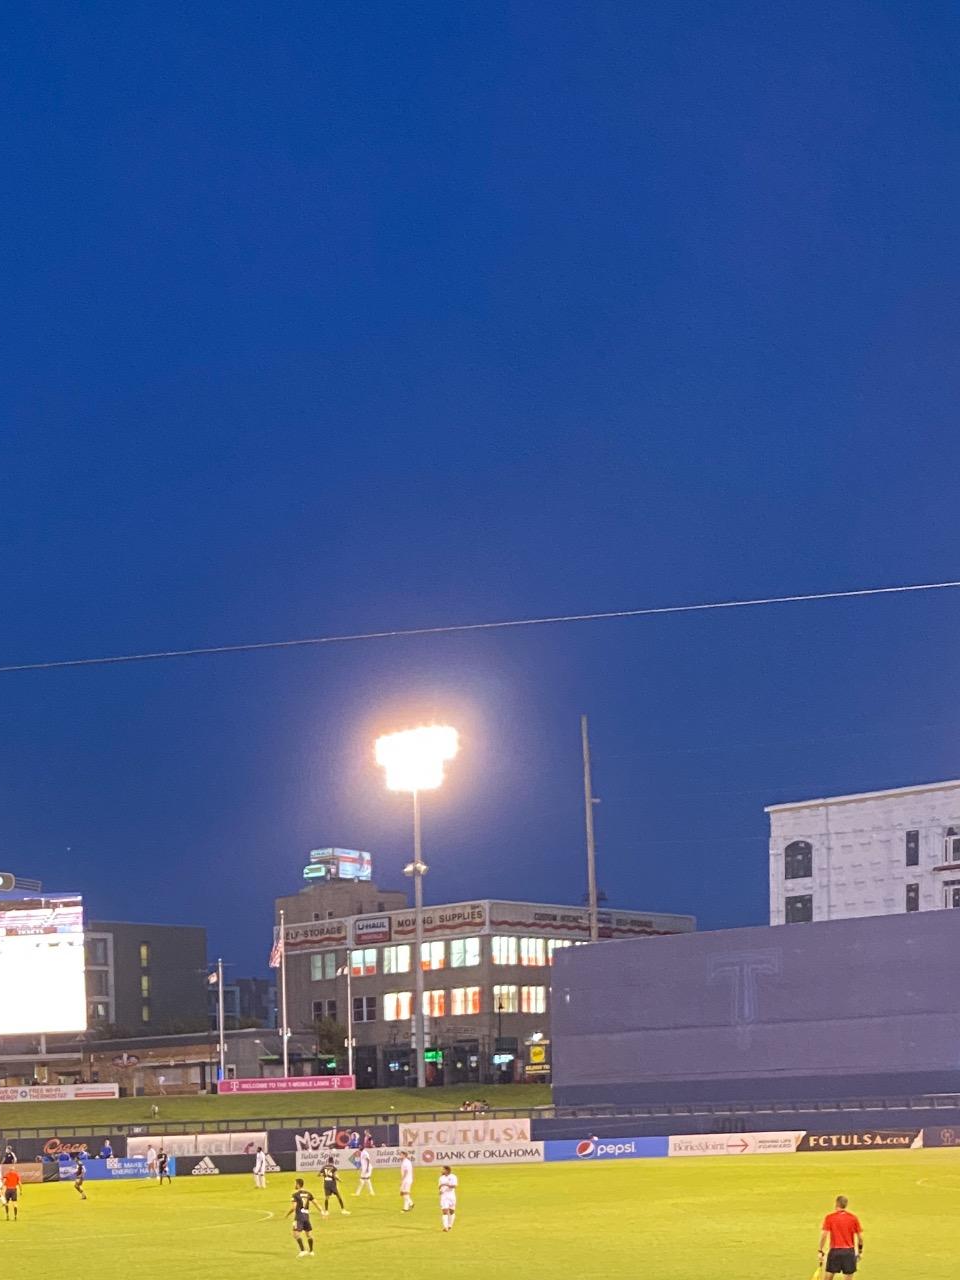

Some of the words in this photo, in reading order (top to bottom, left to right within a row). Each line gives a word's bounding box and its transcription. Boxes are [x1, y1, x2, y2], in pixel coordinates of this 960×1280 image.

[397, 917, 433, 928] MOVNG
[439, 911, 483, 923] SUPPLIES
[285, 926, 342, 940] ELF-STORAGE
[423, 1130, 447, 1143] FC
[459, 1128, 529, 1142] TULSA
[436, 1152, 466, 1160] BANK
[468, 1151, 481, 1159] OF
[483, 1148, 541, 1159] OKLAHOMA
[597, 1140, 636, 1156] pepsi
[191, 1167, 220, 1176] adidas
